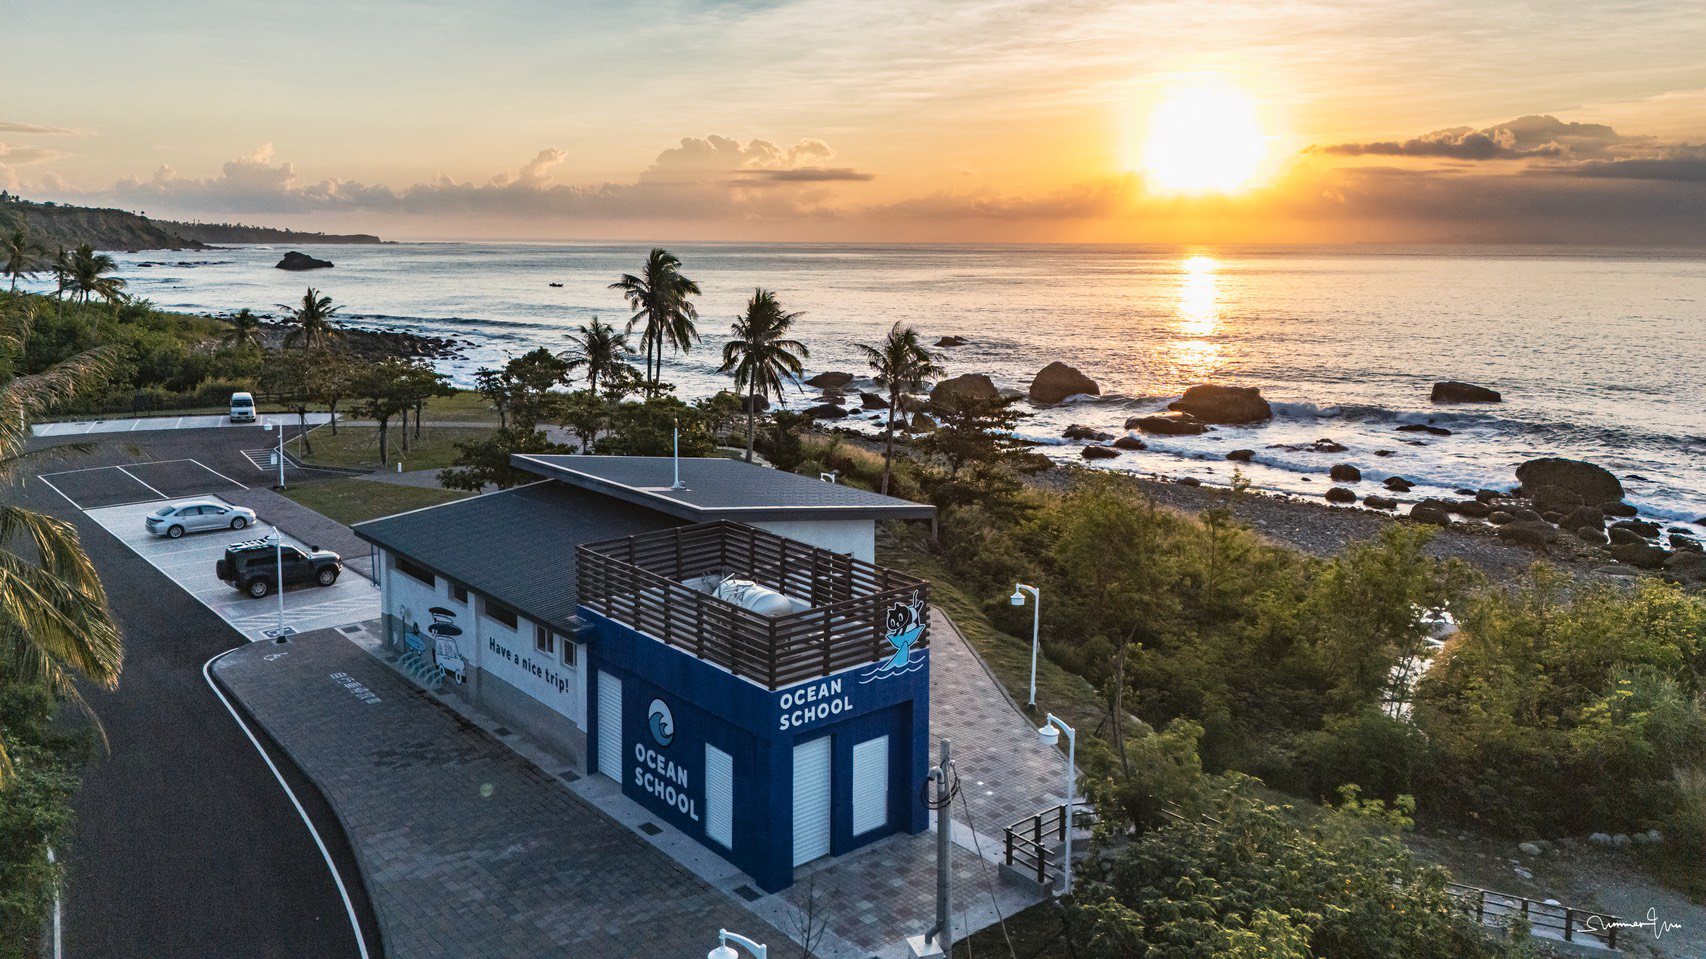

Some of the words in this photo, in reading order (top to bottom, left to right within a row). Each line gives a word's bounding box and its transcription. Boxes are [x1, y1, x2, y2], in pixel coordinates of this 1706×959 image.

[489, 637, 511, 661] Have
[514, 655, 519, 665] a
[522, 658, 542, 679] nice
[545, 672, 569, 693] trip!
[779, 696, 853, 731] SCHOOL
[780, 678, 842, 710] OCEAN
[635, 743, 688, 789] OCEAN
[635, 767, 699, 821] SCHOOL
